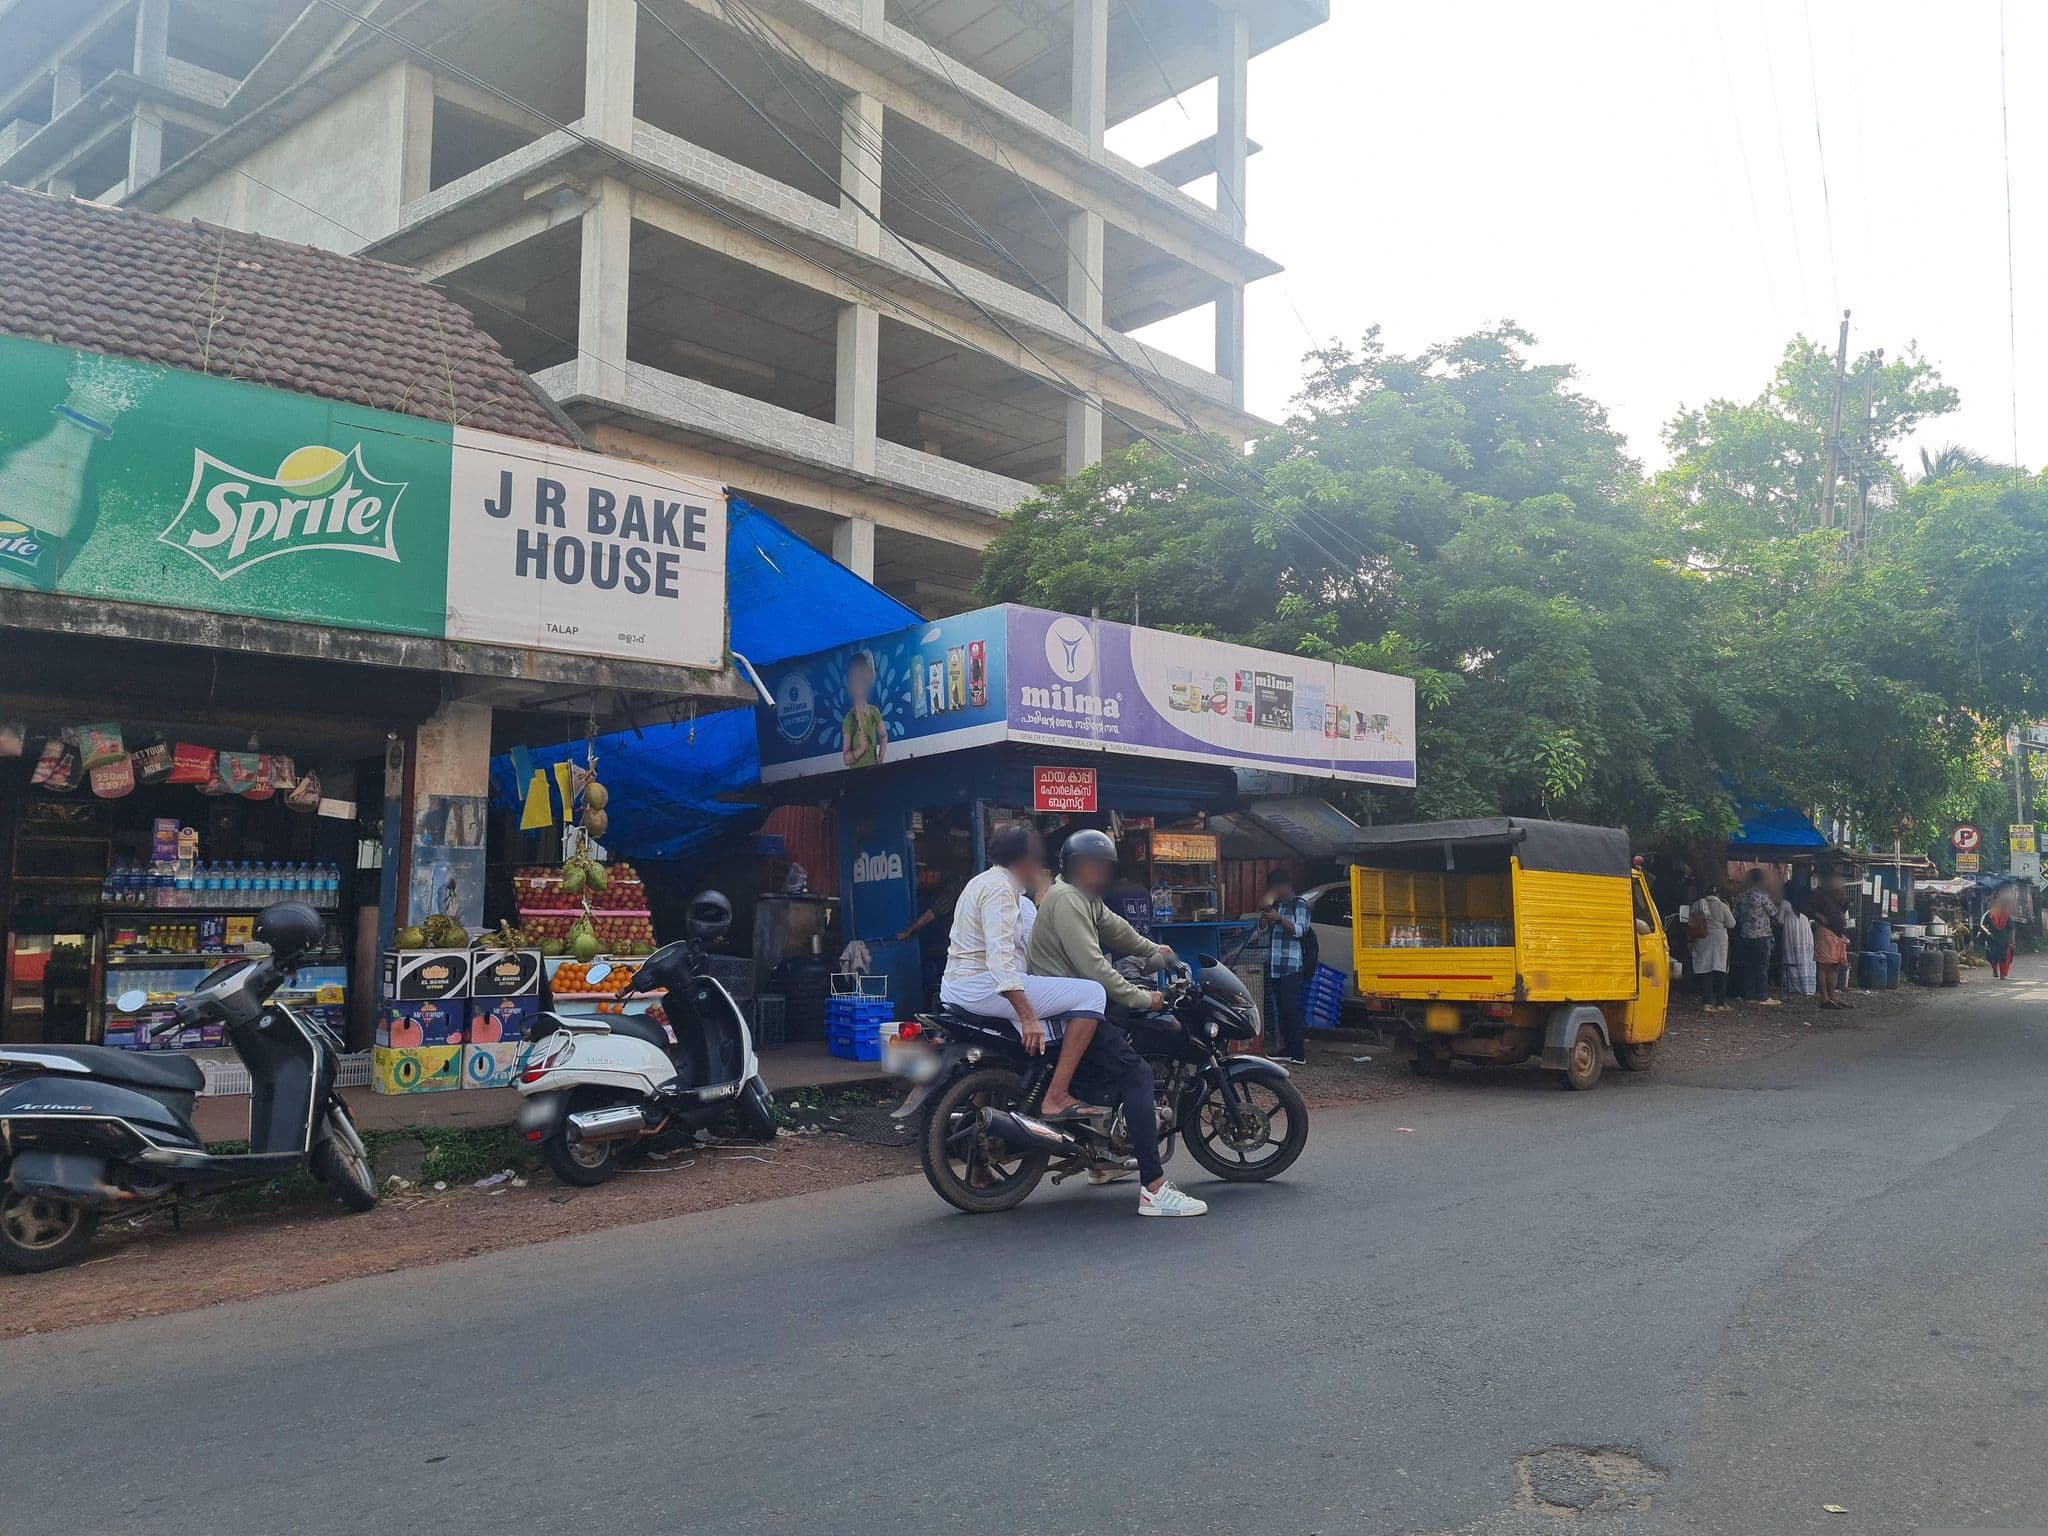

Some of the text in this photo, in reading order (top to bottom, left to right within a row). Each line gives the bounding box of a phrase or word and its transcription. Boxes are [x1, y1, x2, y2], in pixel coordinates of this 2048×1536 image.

[188, 471, 383, 560] Sprite
[484, 470, 707, 551] J R BAKE
[515, 528, 680, 599] HOUSE
[545, 623, 579, 635] TALAP
[1255, 675, 1293, 691] milma
[1021, 683, 1120, 718] milma
[144, 744, 166, 756] YOUR
[96, 770, 129, 782] 250ml
[144, 762, 161, 775] NOW
